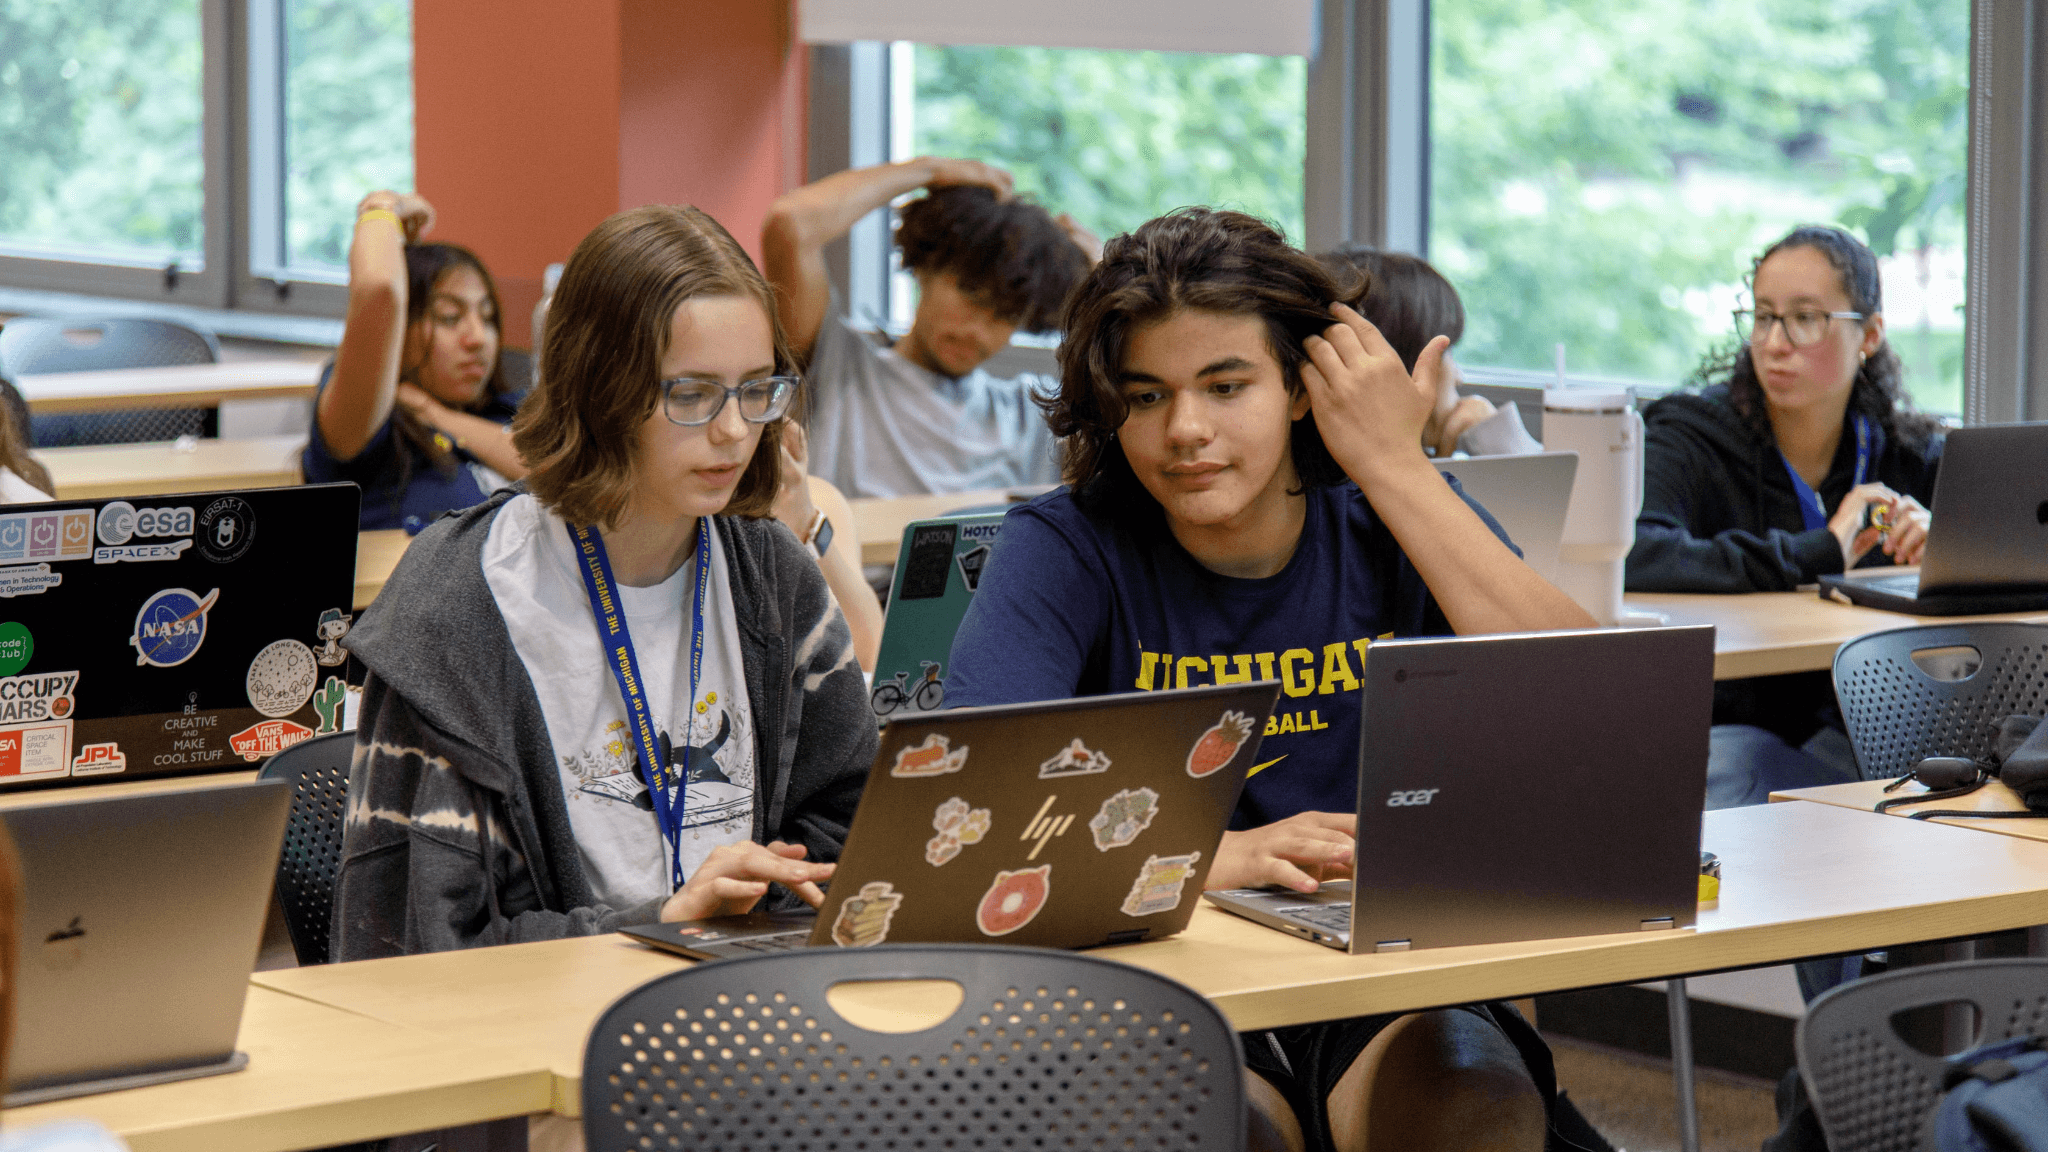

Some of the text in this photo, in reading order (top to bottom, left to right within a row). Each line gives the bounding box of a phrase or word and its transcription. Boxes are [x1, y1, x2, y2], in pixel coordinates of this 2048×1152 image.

[200, 499, 243, 526] EIRSAT-1
[98, 543, 180, 559] SPACEX
[581, 541, 596, 555] OF
[21, 575, 60, 584] Technology
[587, 556, 615, 615] UNIVERSITY
[6, 584, 45, 594] Operations
[143, 619, 199, 638] NASA
[606, 614, 620, 636] THE
[695, 631, 703, 649] THE
[250, 641, 315, 681] TAKE THE LONG WAY HOME
[0, 676, 76, 700] CCUPY
[0, 699, 47, 721] ARS
[184, 704, 197, 715] BE
[164, 715, 218, 730] CREATIVE
[616, 646, 664, 793] THE UNIVERSITY OF MICHIGAN
[26, 733, 56, 743] CRITICAL
[182, 729, 198, 737] AND
[255, 723, 284, 738] VANS
[26, 741, 48, 750] SPACE
[173, 738, 205, 751] MAKE
[259, 737, 279, 751] THE
[76, 746, 121, 764] JPL
[153, 749, 223, 766] COOL STUFF
[1387, 788, 1440, 807] acer
